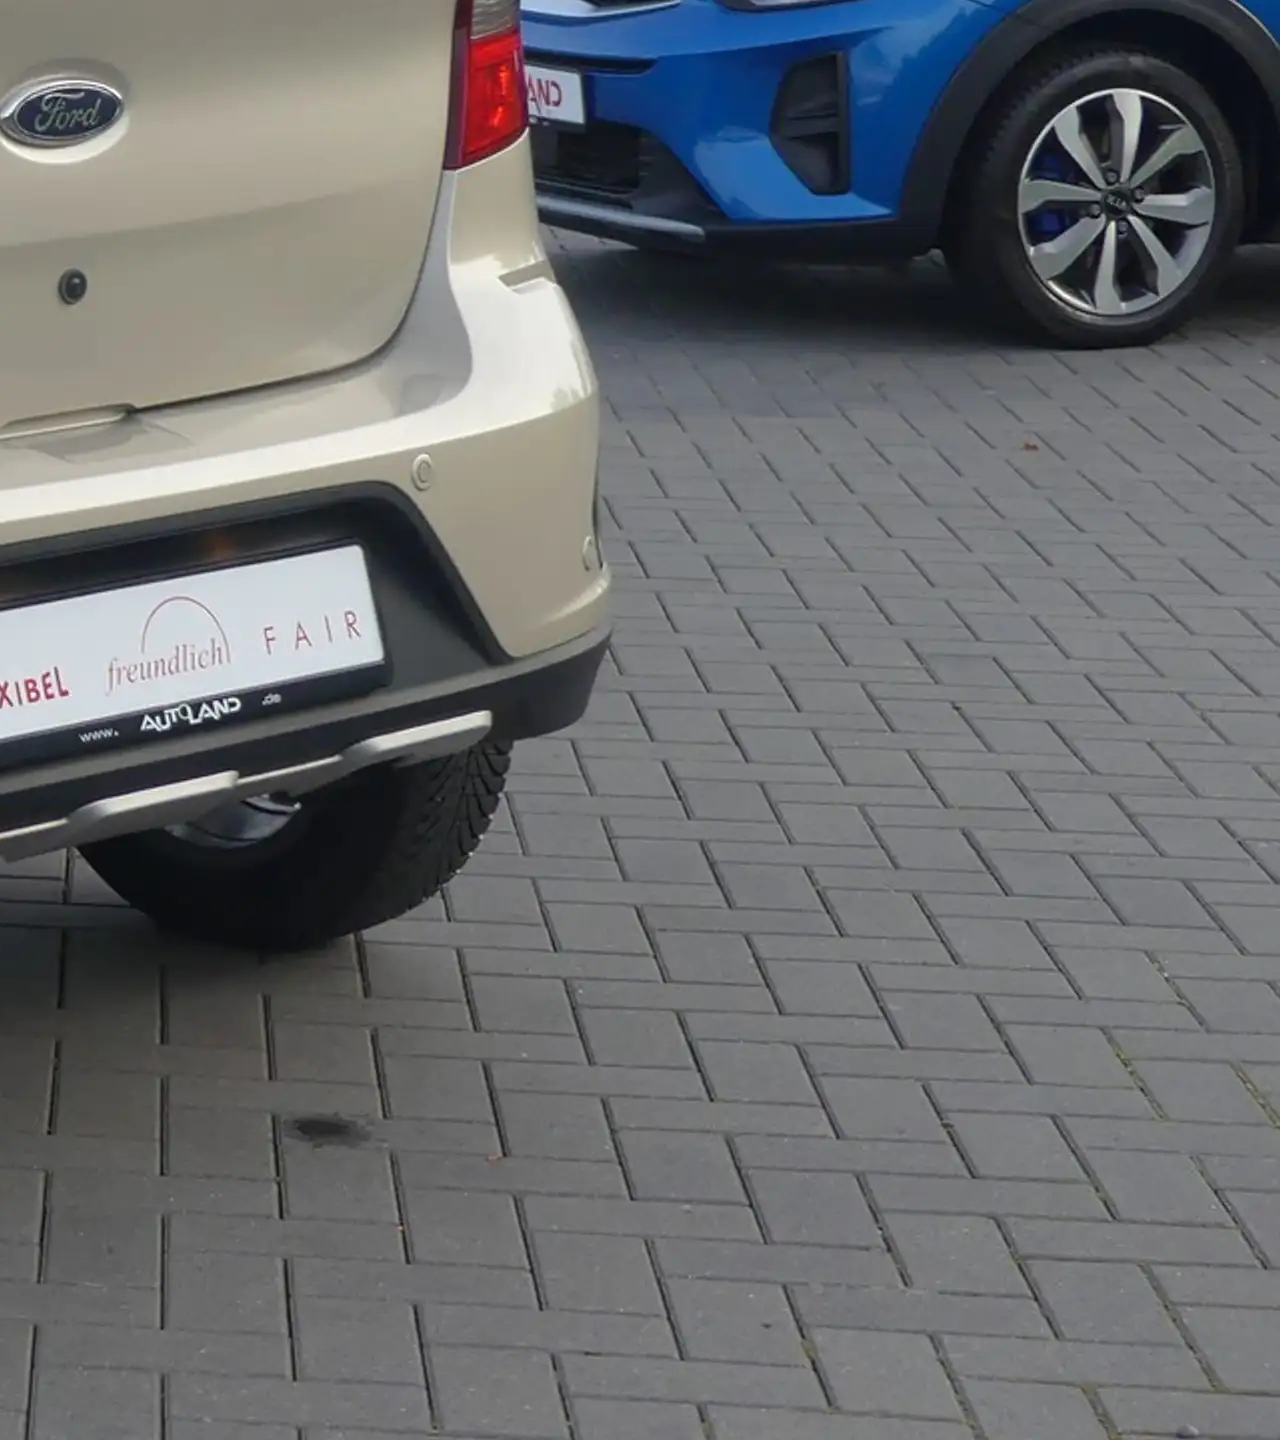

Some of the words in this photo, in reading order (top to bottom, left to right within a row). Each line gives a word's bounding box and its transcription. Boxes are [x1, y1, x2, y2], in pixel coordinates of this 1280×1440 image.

[34, 91, 102, 132] Ford
[105, 638, 225, 697] freundlich
[263, 610, 362, 656] FAIR
[79, 728, 120, 743] www.
[140, 696, 242, 732] AUTOLAND
[262, 693, 282, 707] .de
